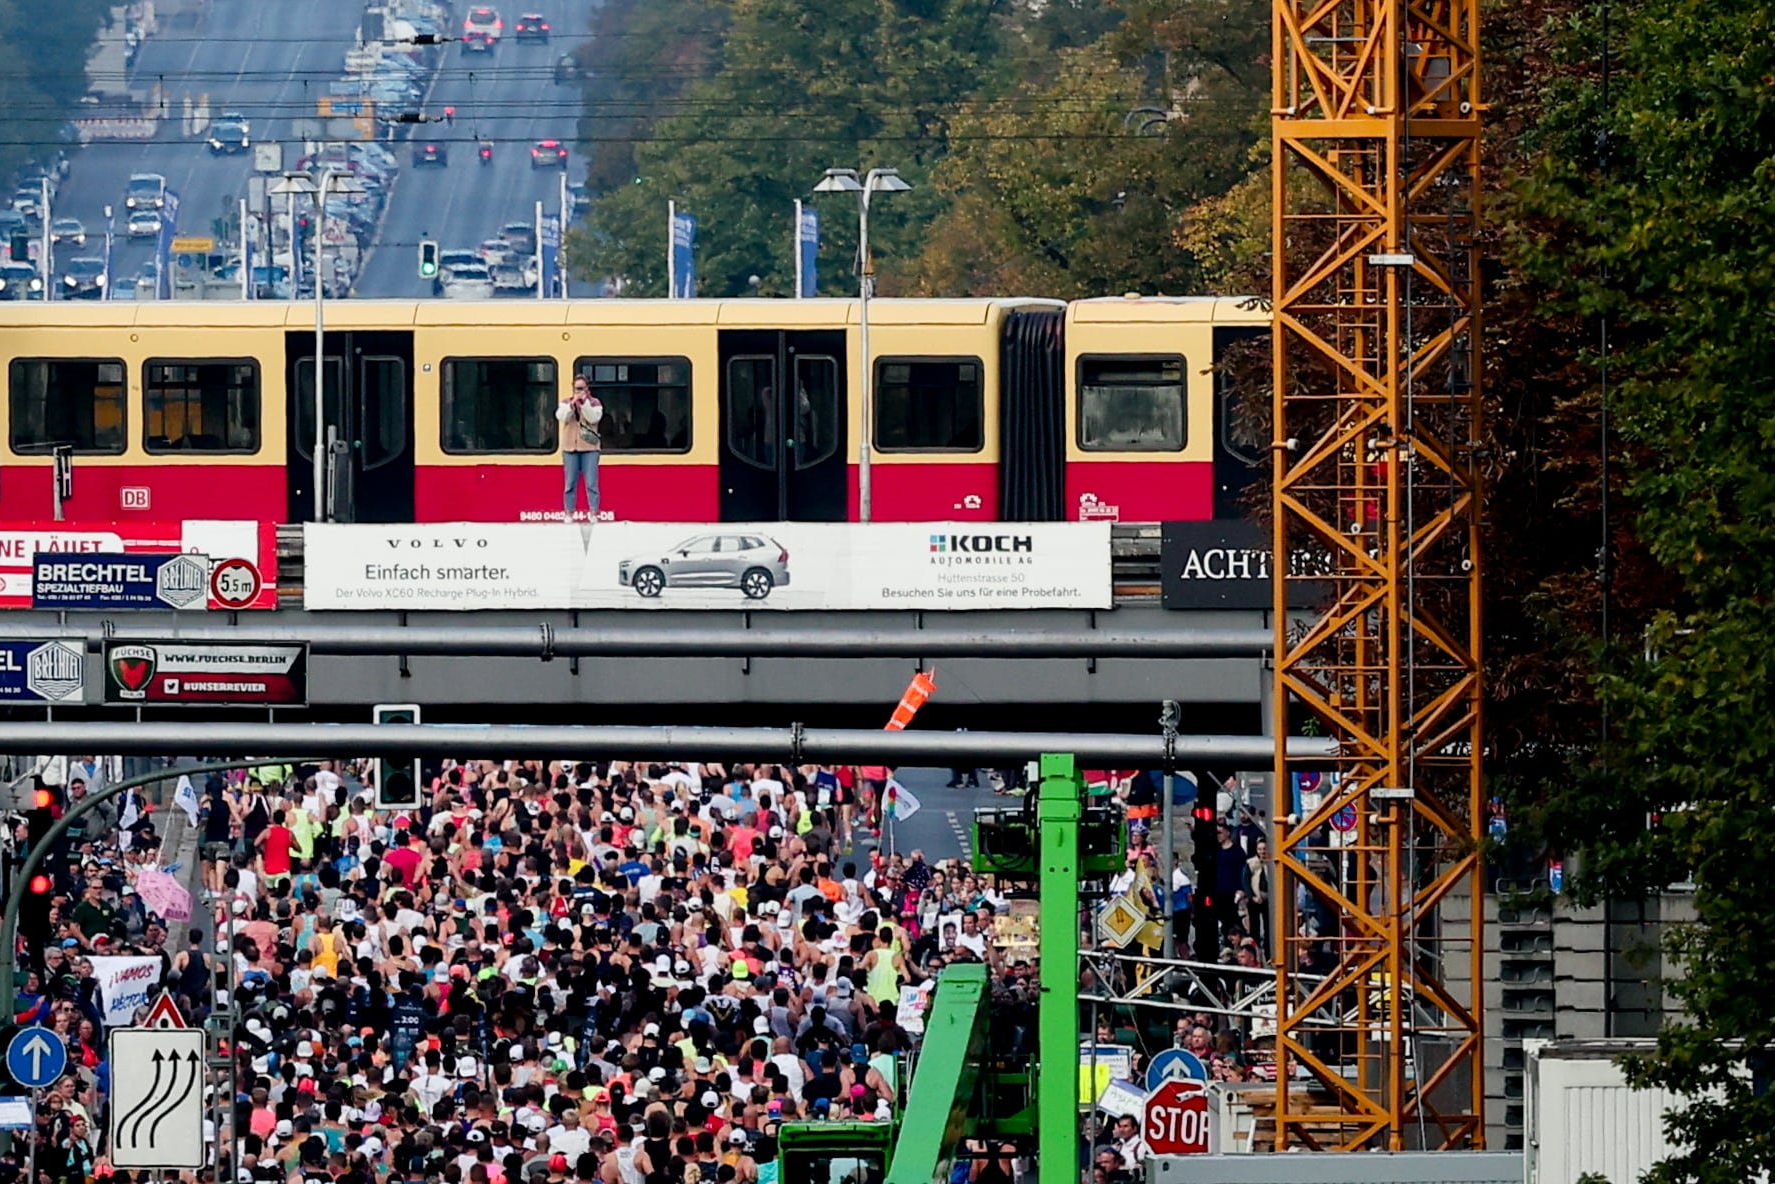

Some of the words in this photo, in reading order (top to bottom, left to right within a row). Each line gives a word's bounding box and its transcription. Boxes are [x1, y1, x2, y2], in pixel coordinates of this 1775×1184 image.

[125, 491, 146, 505] DB
[386, 538, 488, 549] VOLVO
[951, 535, 1033, 552] KOCH
[930, 556, 1011, 566] AUTOMOBILE
[1018, 556, 1033, 564] AG
[37, 565, 153, 582] BRECHTEL
[365, 564, 431, 580] Einfach
[436, 564, 510, 580] smarter.
[1011, 573, 1025, 582] 50
[36, 584, 124, 594] SPEZIALTIEFBAU
[337, 588, 353, 598] Der
[356, 588, 383, 598] Volvo
[417, 588, 463, 600] Recharge
[882, 588, 934, 598] Besuchen
[938, 588, 953, 598] Sie
[957, 590, 976, 598] uns
[979, 587, 994, 598] für
[997, 588, 1018, 597] eine
[1022, 587, 1082, 598] Probefahrt.
